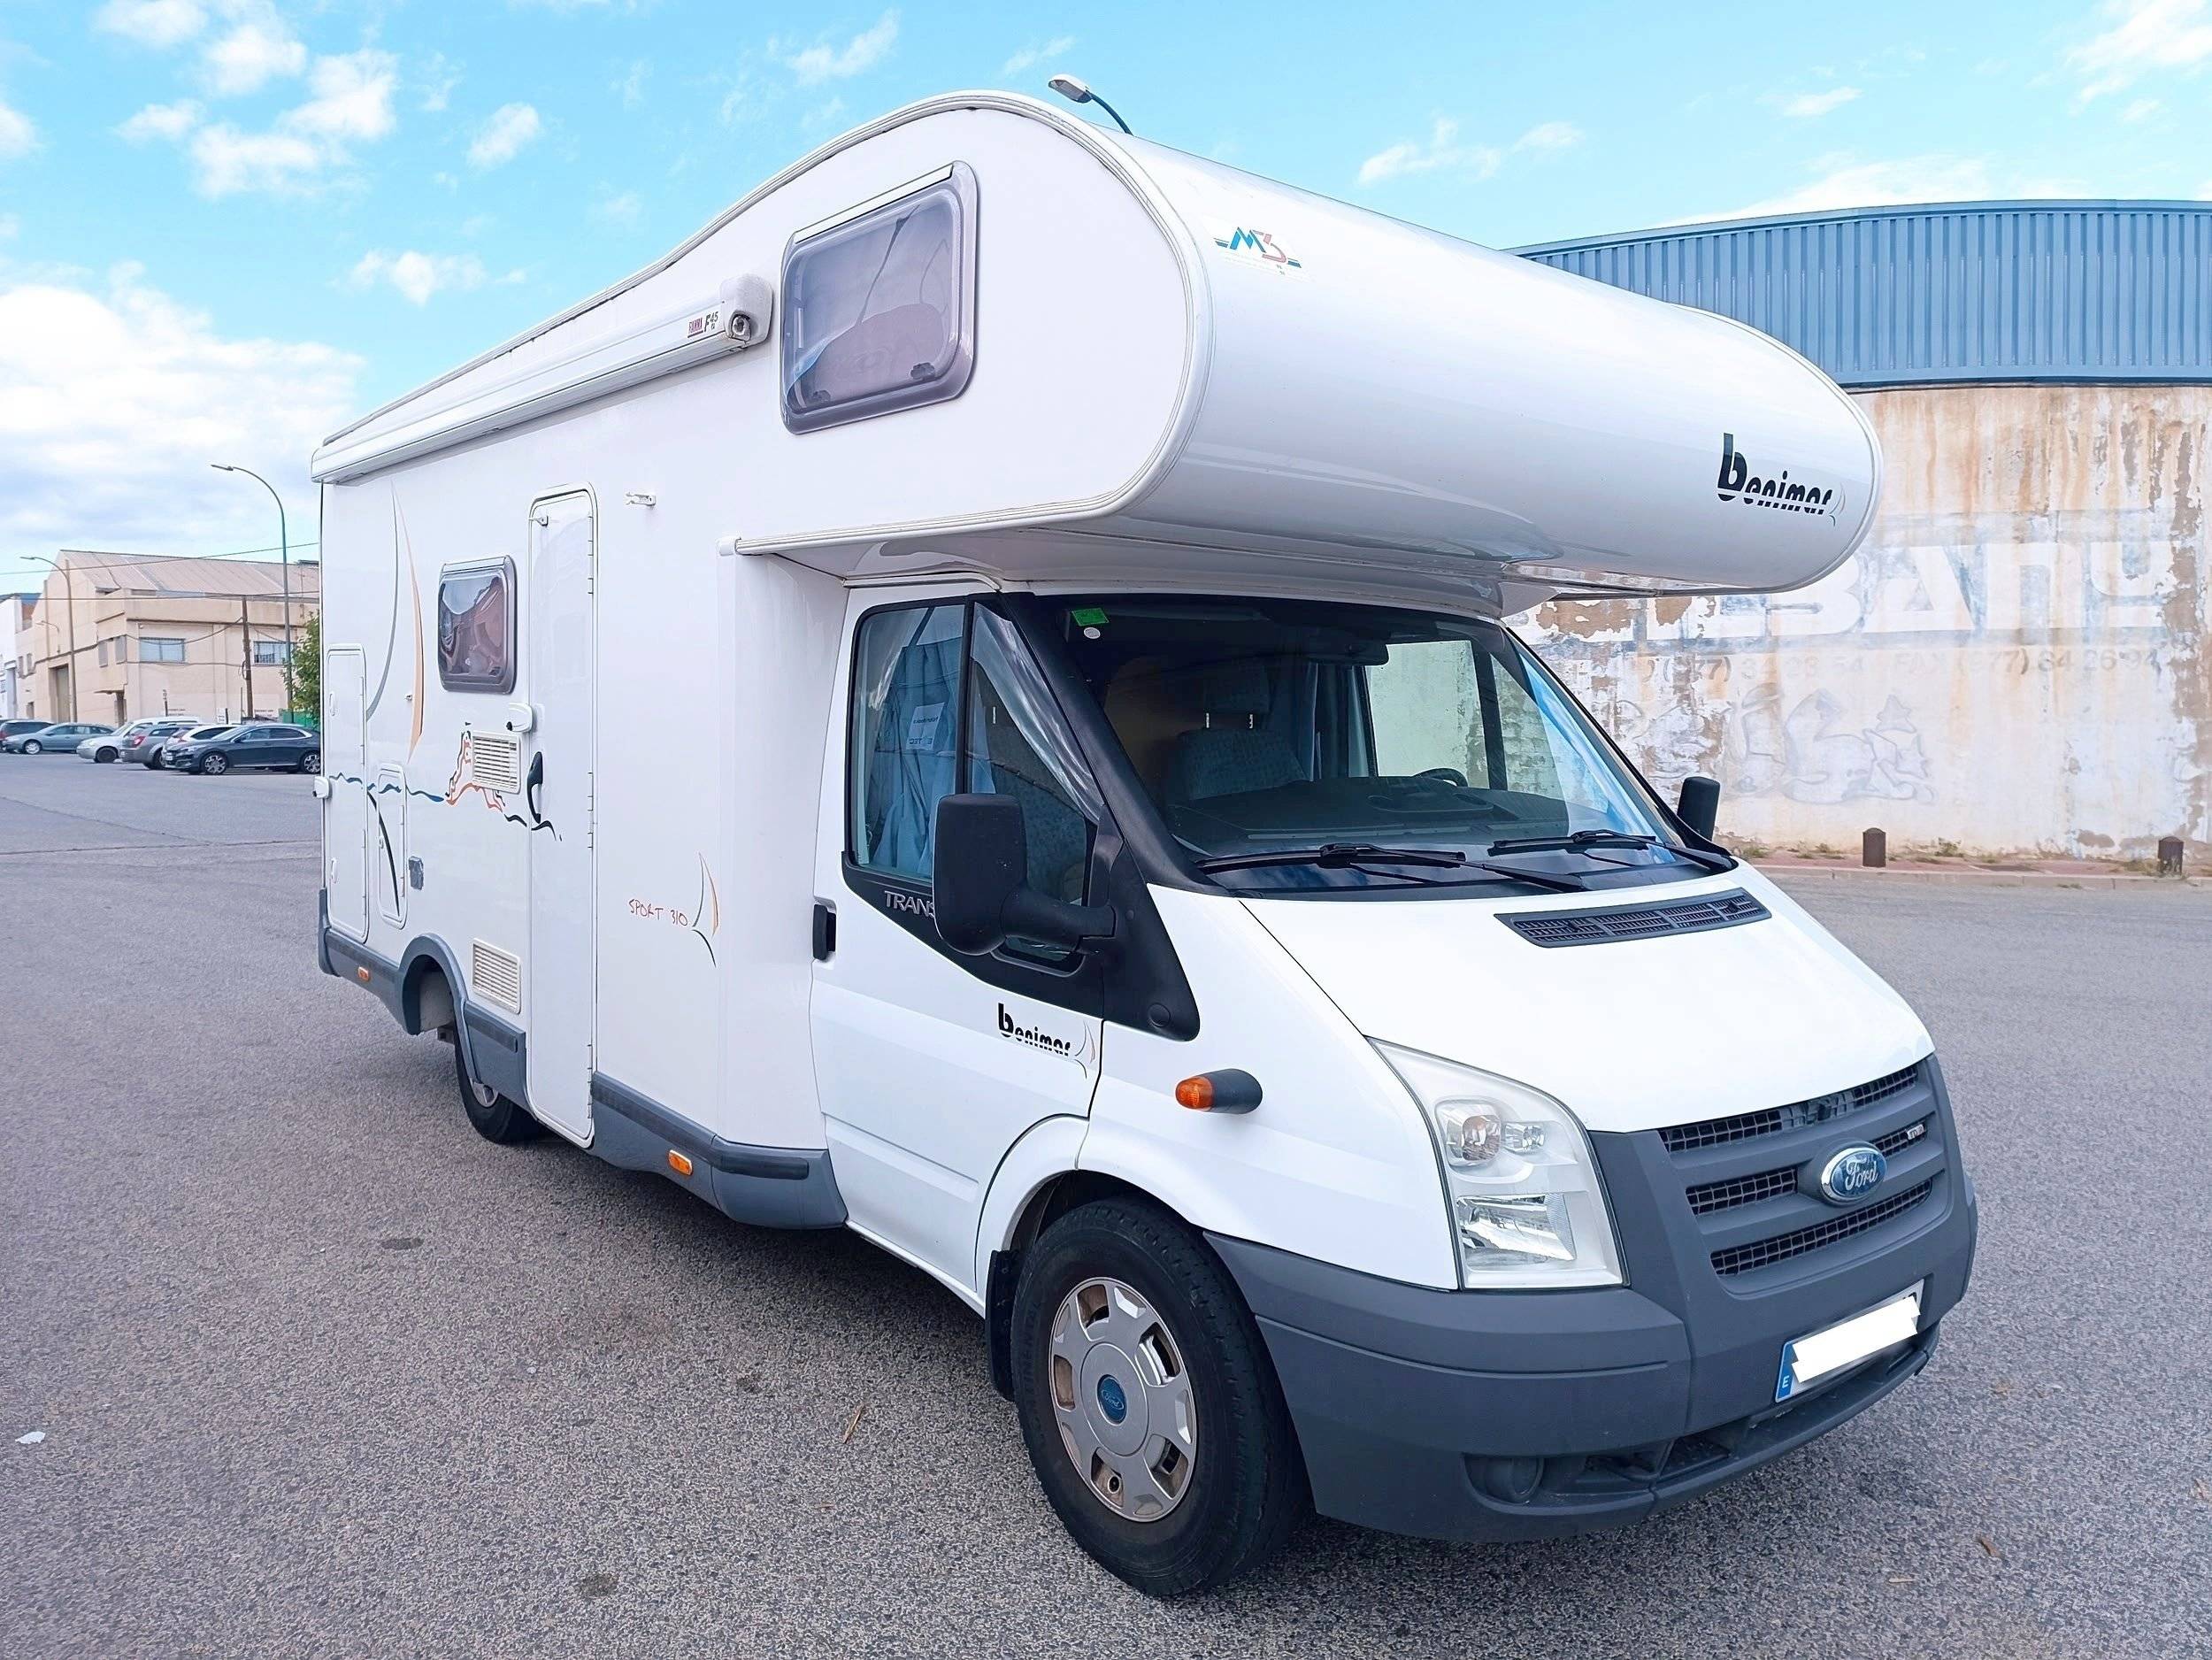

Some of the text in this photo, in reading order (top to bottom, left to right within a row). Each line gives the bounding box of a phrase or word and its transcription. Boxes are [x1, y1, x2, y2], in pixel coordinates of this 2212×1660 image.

[670, 909, 688, 926] 310
[1845, 1154, 1878, 1191] Ford
[1782, 1375, 1790, 1388] E
